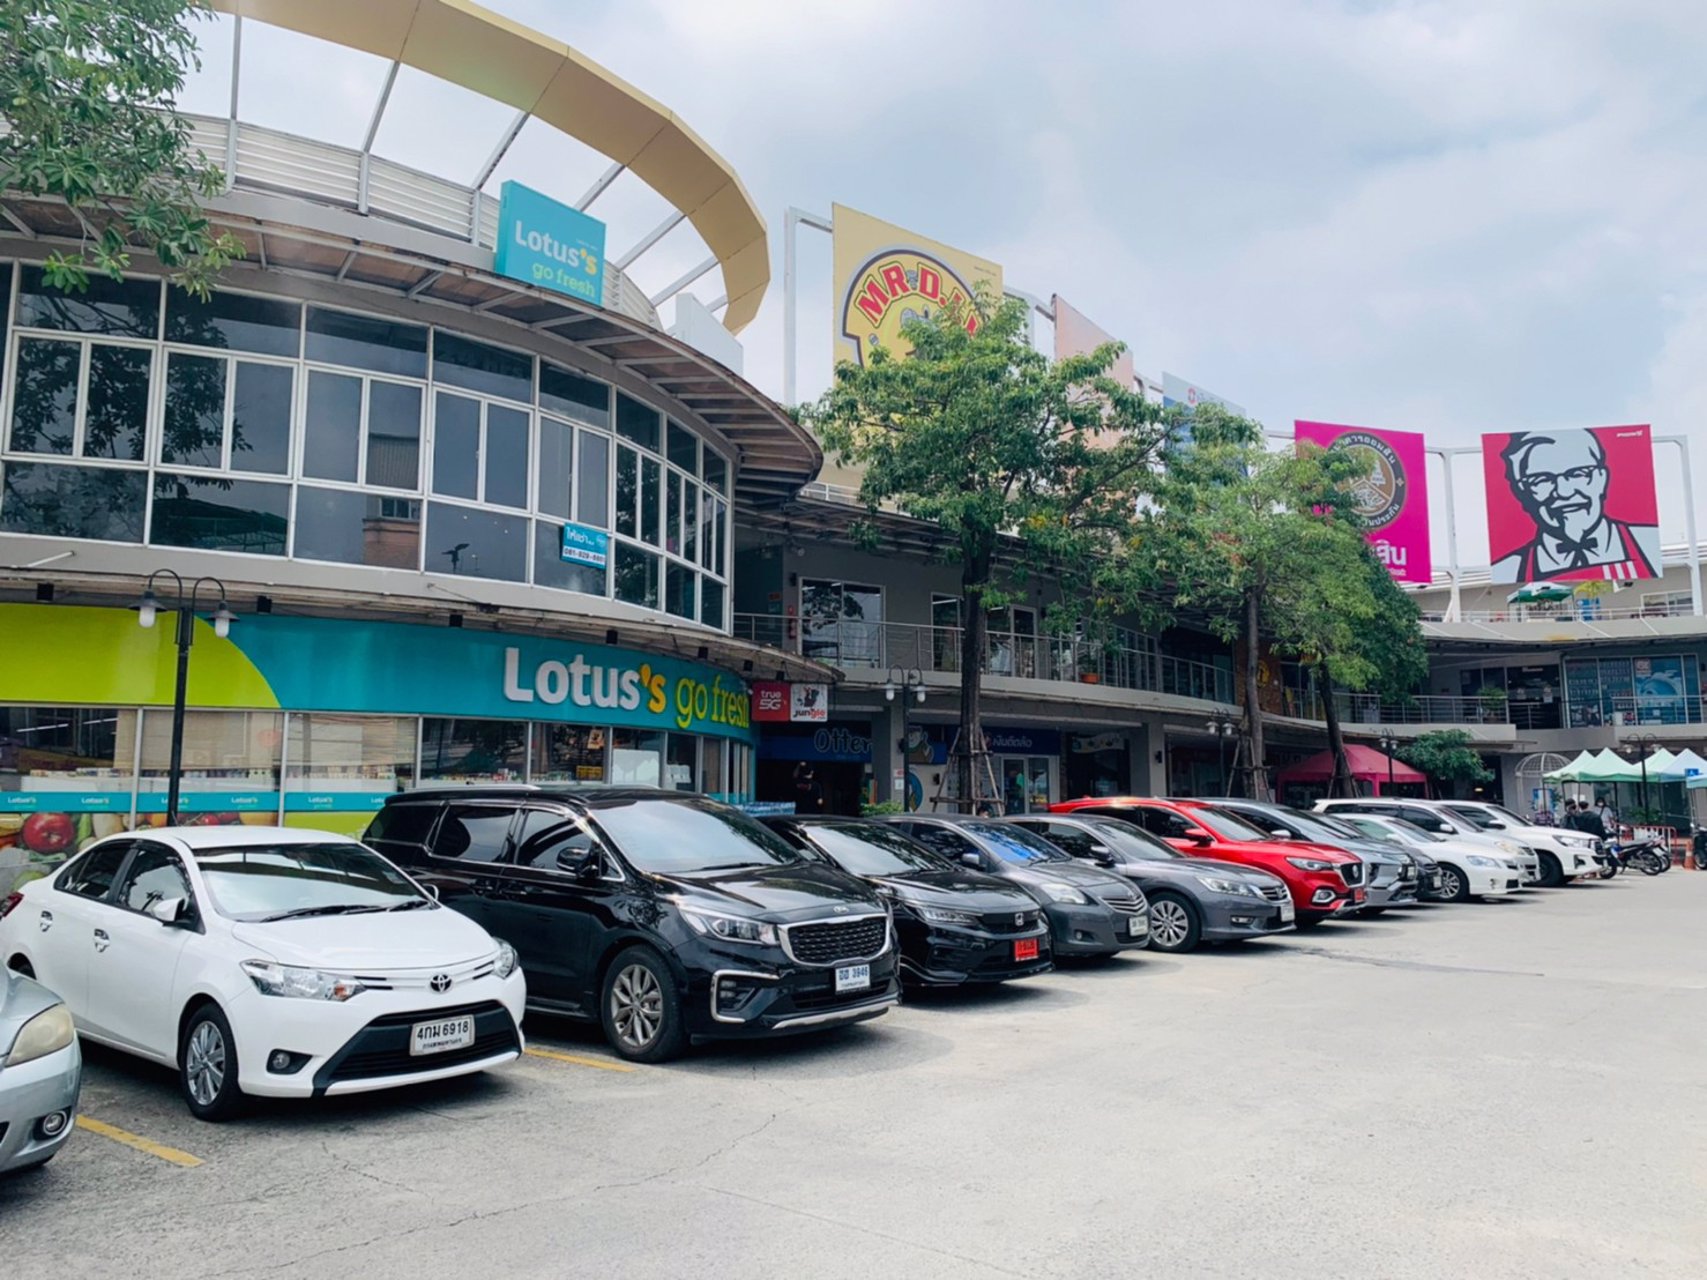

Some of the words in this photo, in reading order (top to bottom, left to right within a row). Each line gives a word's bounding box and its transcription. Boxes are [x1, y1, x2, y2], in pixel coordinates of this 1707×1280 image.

[515, 219, 598, 276] Lotus's
[532, 262, 554, 280] go
[556, 268, 596, 298] fresh
[503, 647, 667, 713] Lotus's
[676, 677, 708, 729] go
[712, 674, 749, 728] fresh
[761, 690, 781, 699] true
[759, 699, 781, 710] 5G
[793, 707, 826, 720] jungle
[417, 1025, 441, 1039] 4กม
[442, 1020, 469, 1036] 6918
